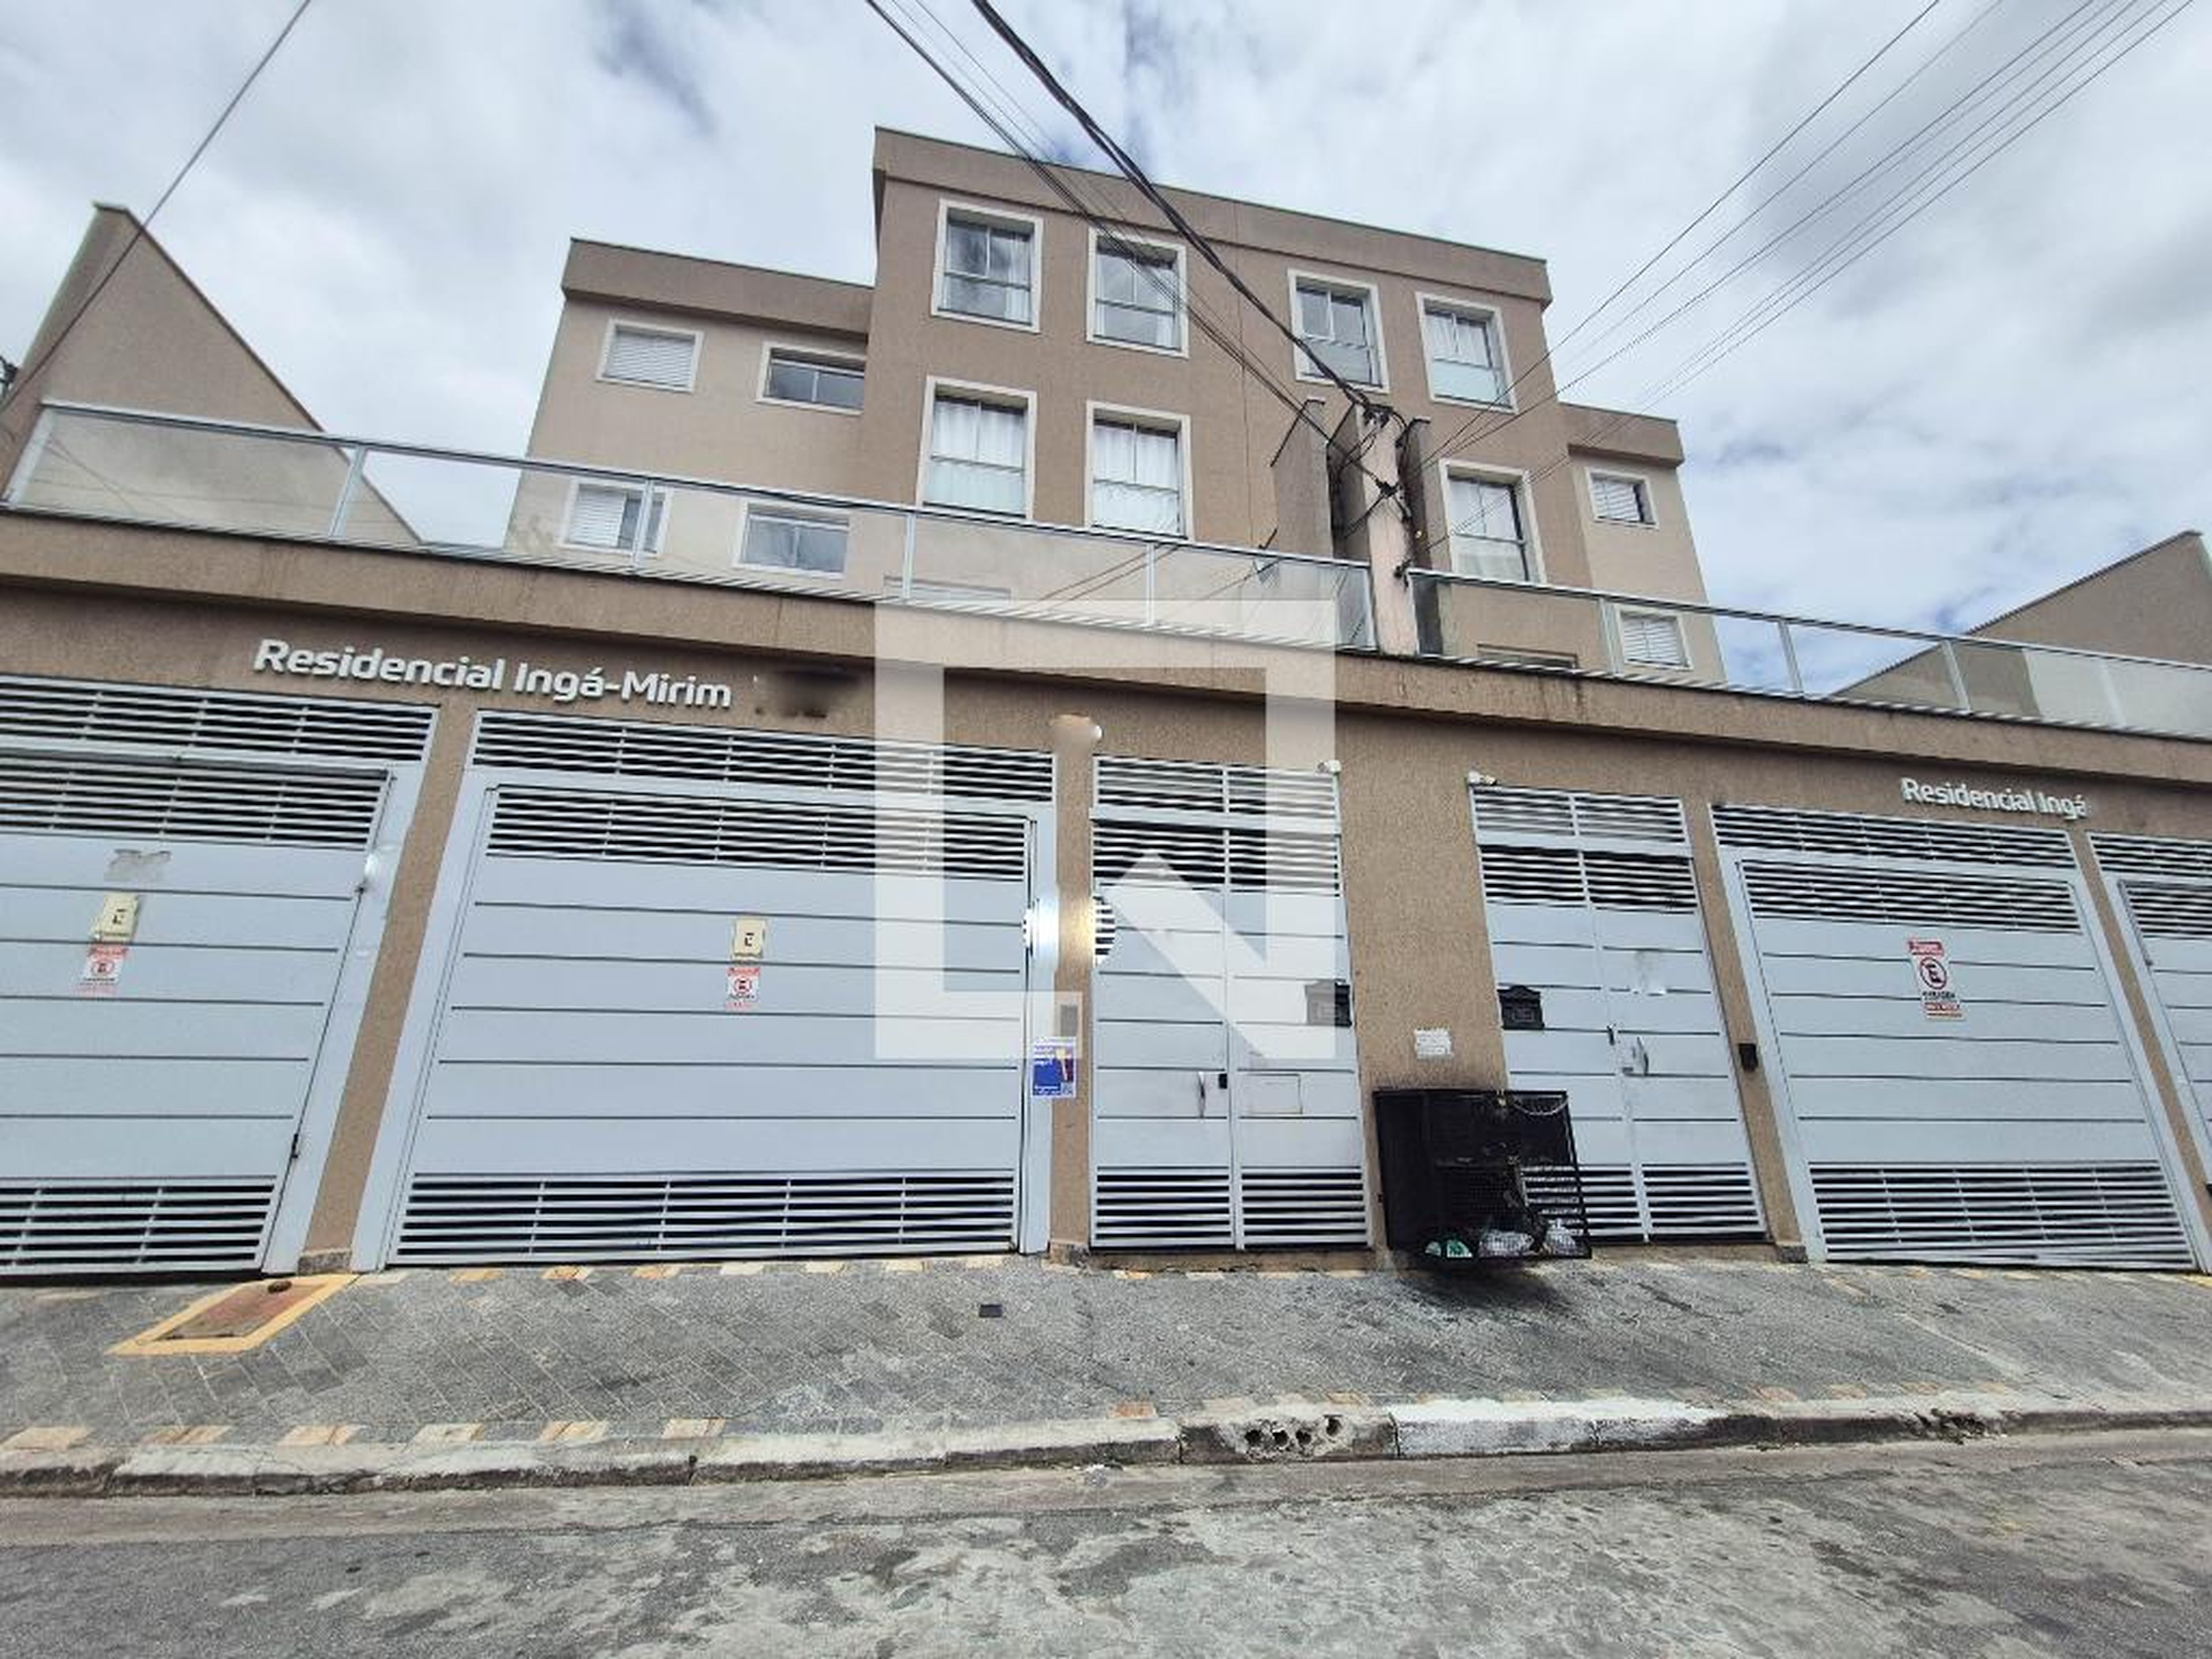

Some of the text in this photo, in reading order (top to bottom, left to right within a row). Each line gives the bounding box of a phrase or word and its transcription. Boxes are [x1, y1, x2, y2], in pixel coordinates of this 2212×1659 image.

[253, 638, 732, 709] Residencial Ingá-Mirim
[1902, 777, 2087, 820] Residencial Ingá
